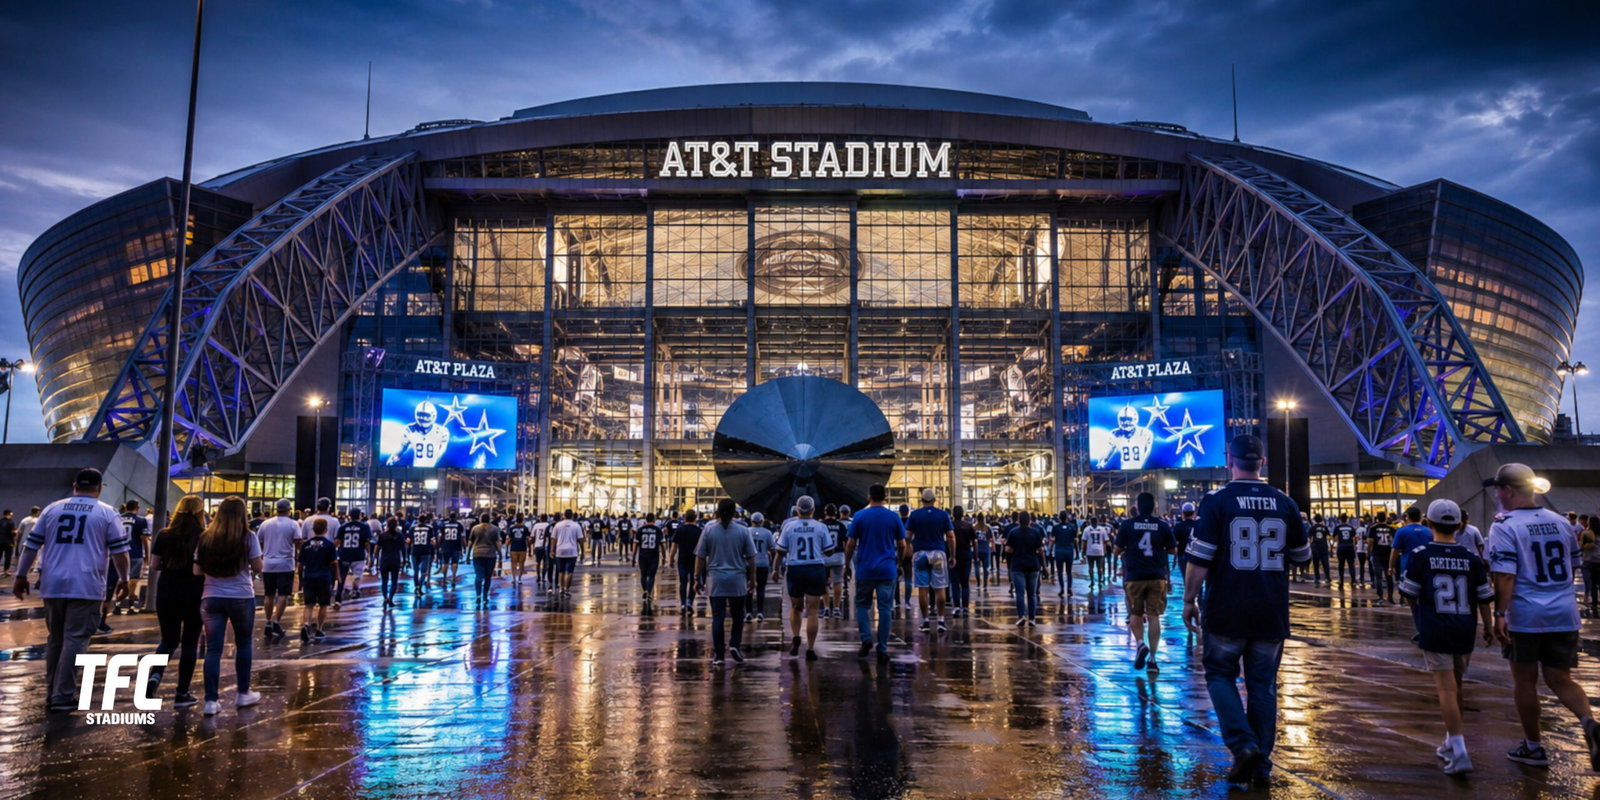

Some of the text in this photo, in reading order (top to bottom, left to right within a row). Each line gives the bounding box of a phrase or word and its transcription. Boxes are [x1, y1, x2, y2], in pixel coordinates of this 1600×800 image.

[659, 141, 951, 178] AT&T STADIUM
[415, 359, 496, 379] AT&T PLAZA
[1111, 360, 1192, 380] AT&T PLAZA
[1236, 496, 1277, 511] WITTEN
[56, 514, 88, 544] 21
[797, 537, 815, 560] 21
[1138, 532, 1153, 557] 4
[1229, 516, 1288, 571] 82
[1531, 540, 1568, 583] 18
[1432, 573, 1472, 615] 21
